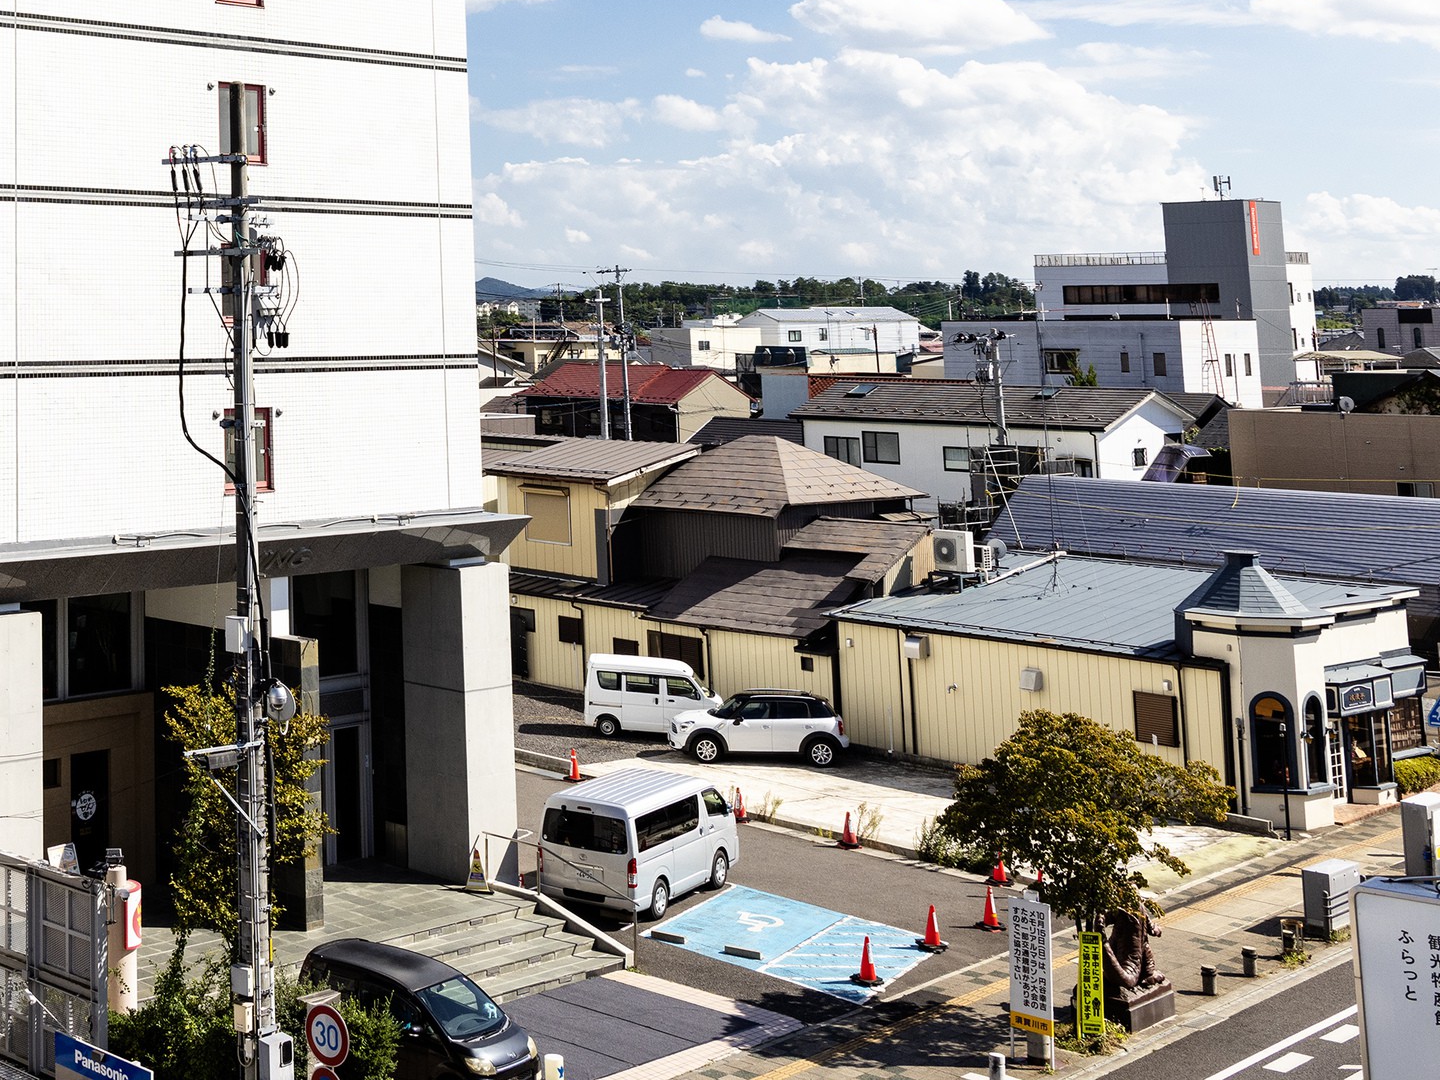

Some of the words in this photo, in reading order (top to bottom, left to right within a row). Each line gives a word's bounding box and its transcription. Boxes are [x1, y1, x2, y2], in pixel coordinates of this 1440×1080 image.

[1082, 945, 1092, 1020] ご協力お願い致します
[1091, 945, 1101, 991] 工事中につき
[315, 1020, 339, 1051] 30
[1014, 1015, 1048, 1031] 須賀川市
